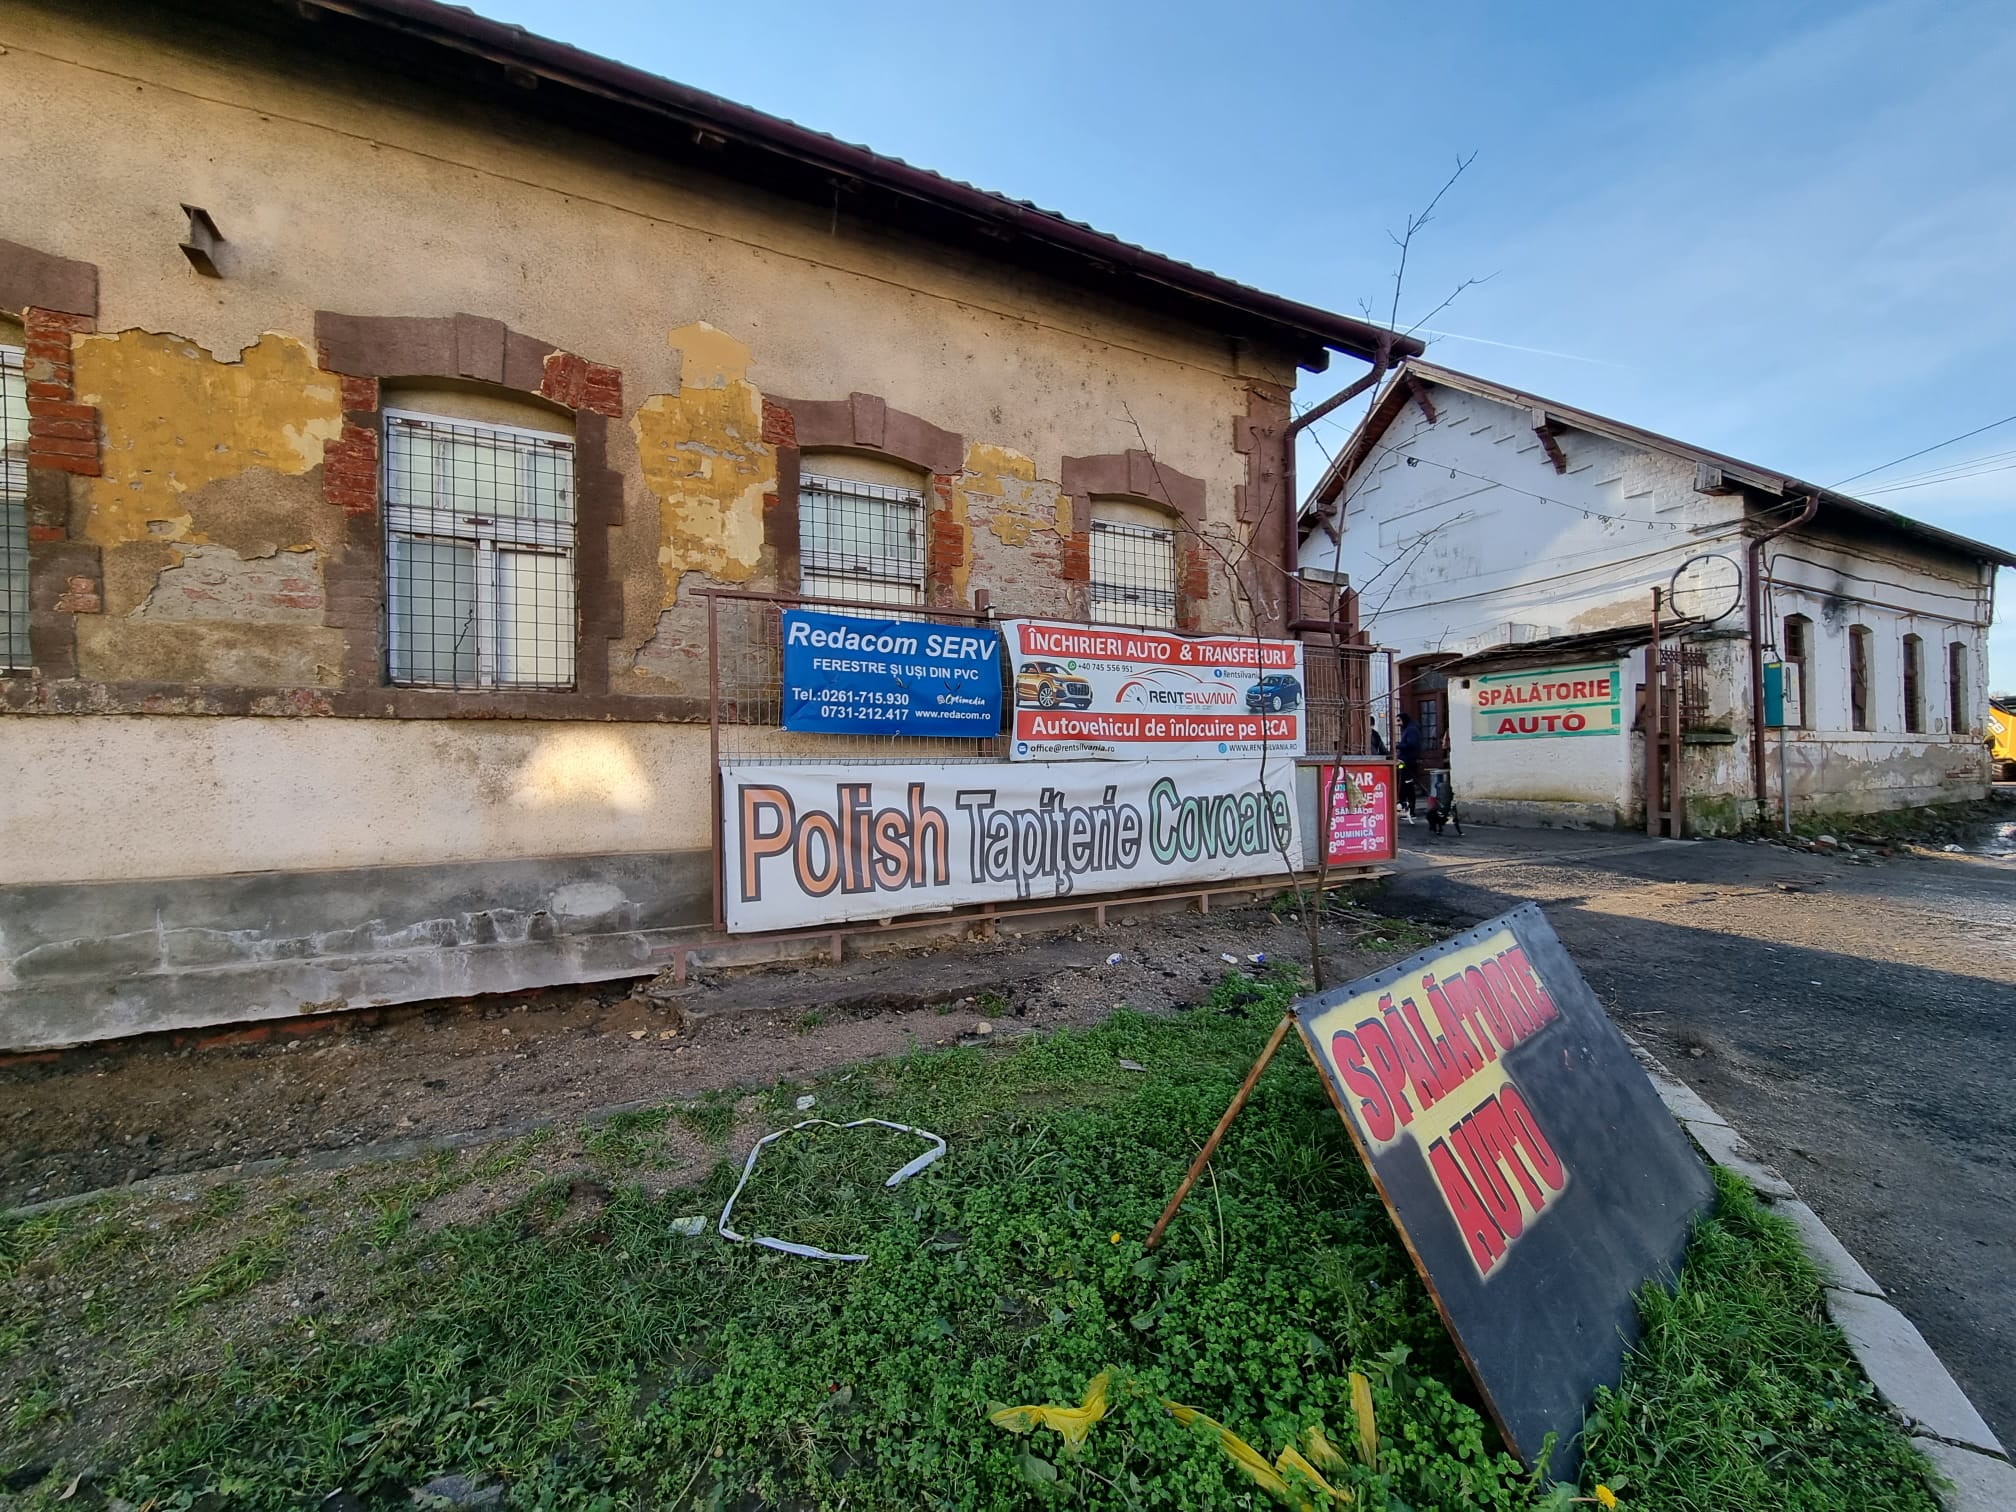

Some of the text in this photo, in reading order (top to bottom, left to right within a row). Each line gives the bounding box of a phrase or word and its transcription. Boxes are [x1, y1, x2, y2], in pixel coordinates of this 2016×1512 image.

[788, 621, 996, 661] Redacom SERV
[1028, 627, 1286, 665] ÎNCHIRIERI AUTO & TRANSFERURI
[813, 658, 886, 674] FERESTRE
[930, 667, 950, 679] DIN
[954, 668, 979, 680] PVC
[1078, 662, 1133, 673] +40 745 556 951
[1478, 678, 1610, 706] SPĂLĂTORIE
[820, 705, 909, 721] 0731-212.417
[915, 709, 991, 720] www.redacom.ro
[1497, 713, 1586, 734] AUTO
[1031, 716, 1288, 739] Autovehicul de înlocuire pe RCA
[738, 782, 949, 903] Polish
[1148, 776, 1292, 865] Covoare
[1331, 944, 1559, 1143] SPĂLĂTORIE
[1428, 1082, 1565, 1276] AUTO
